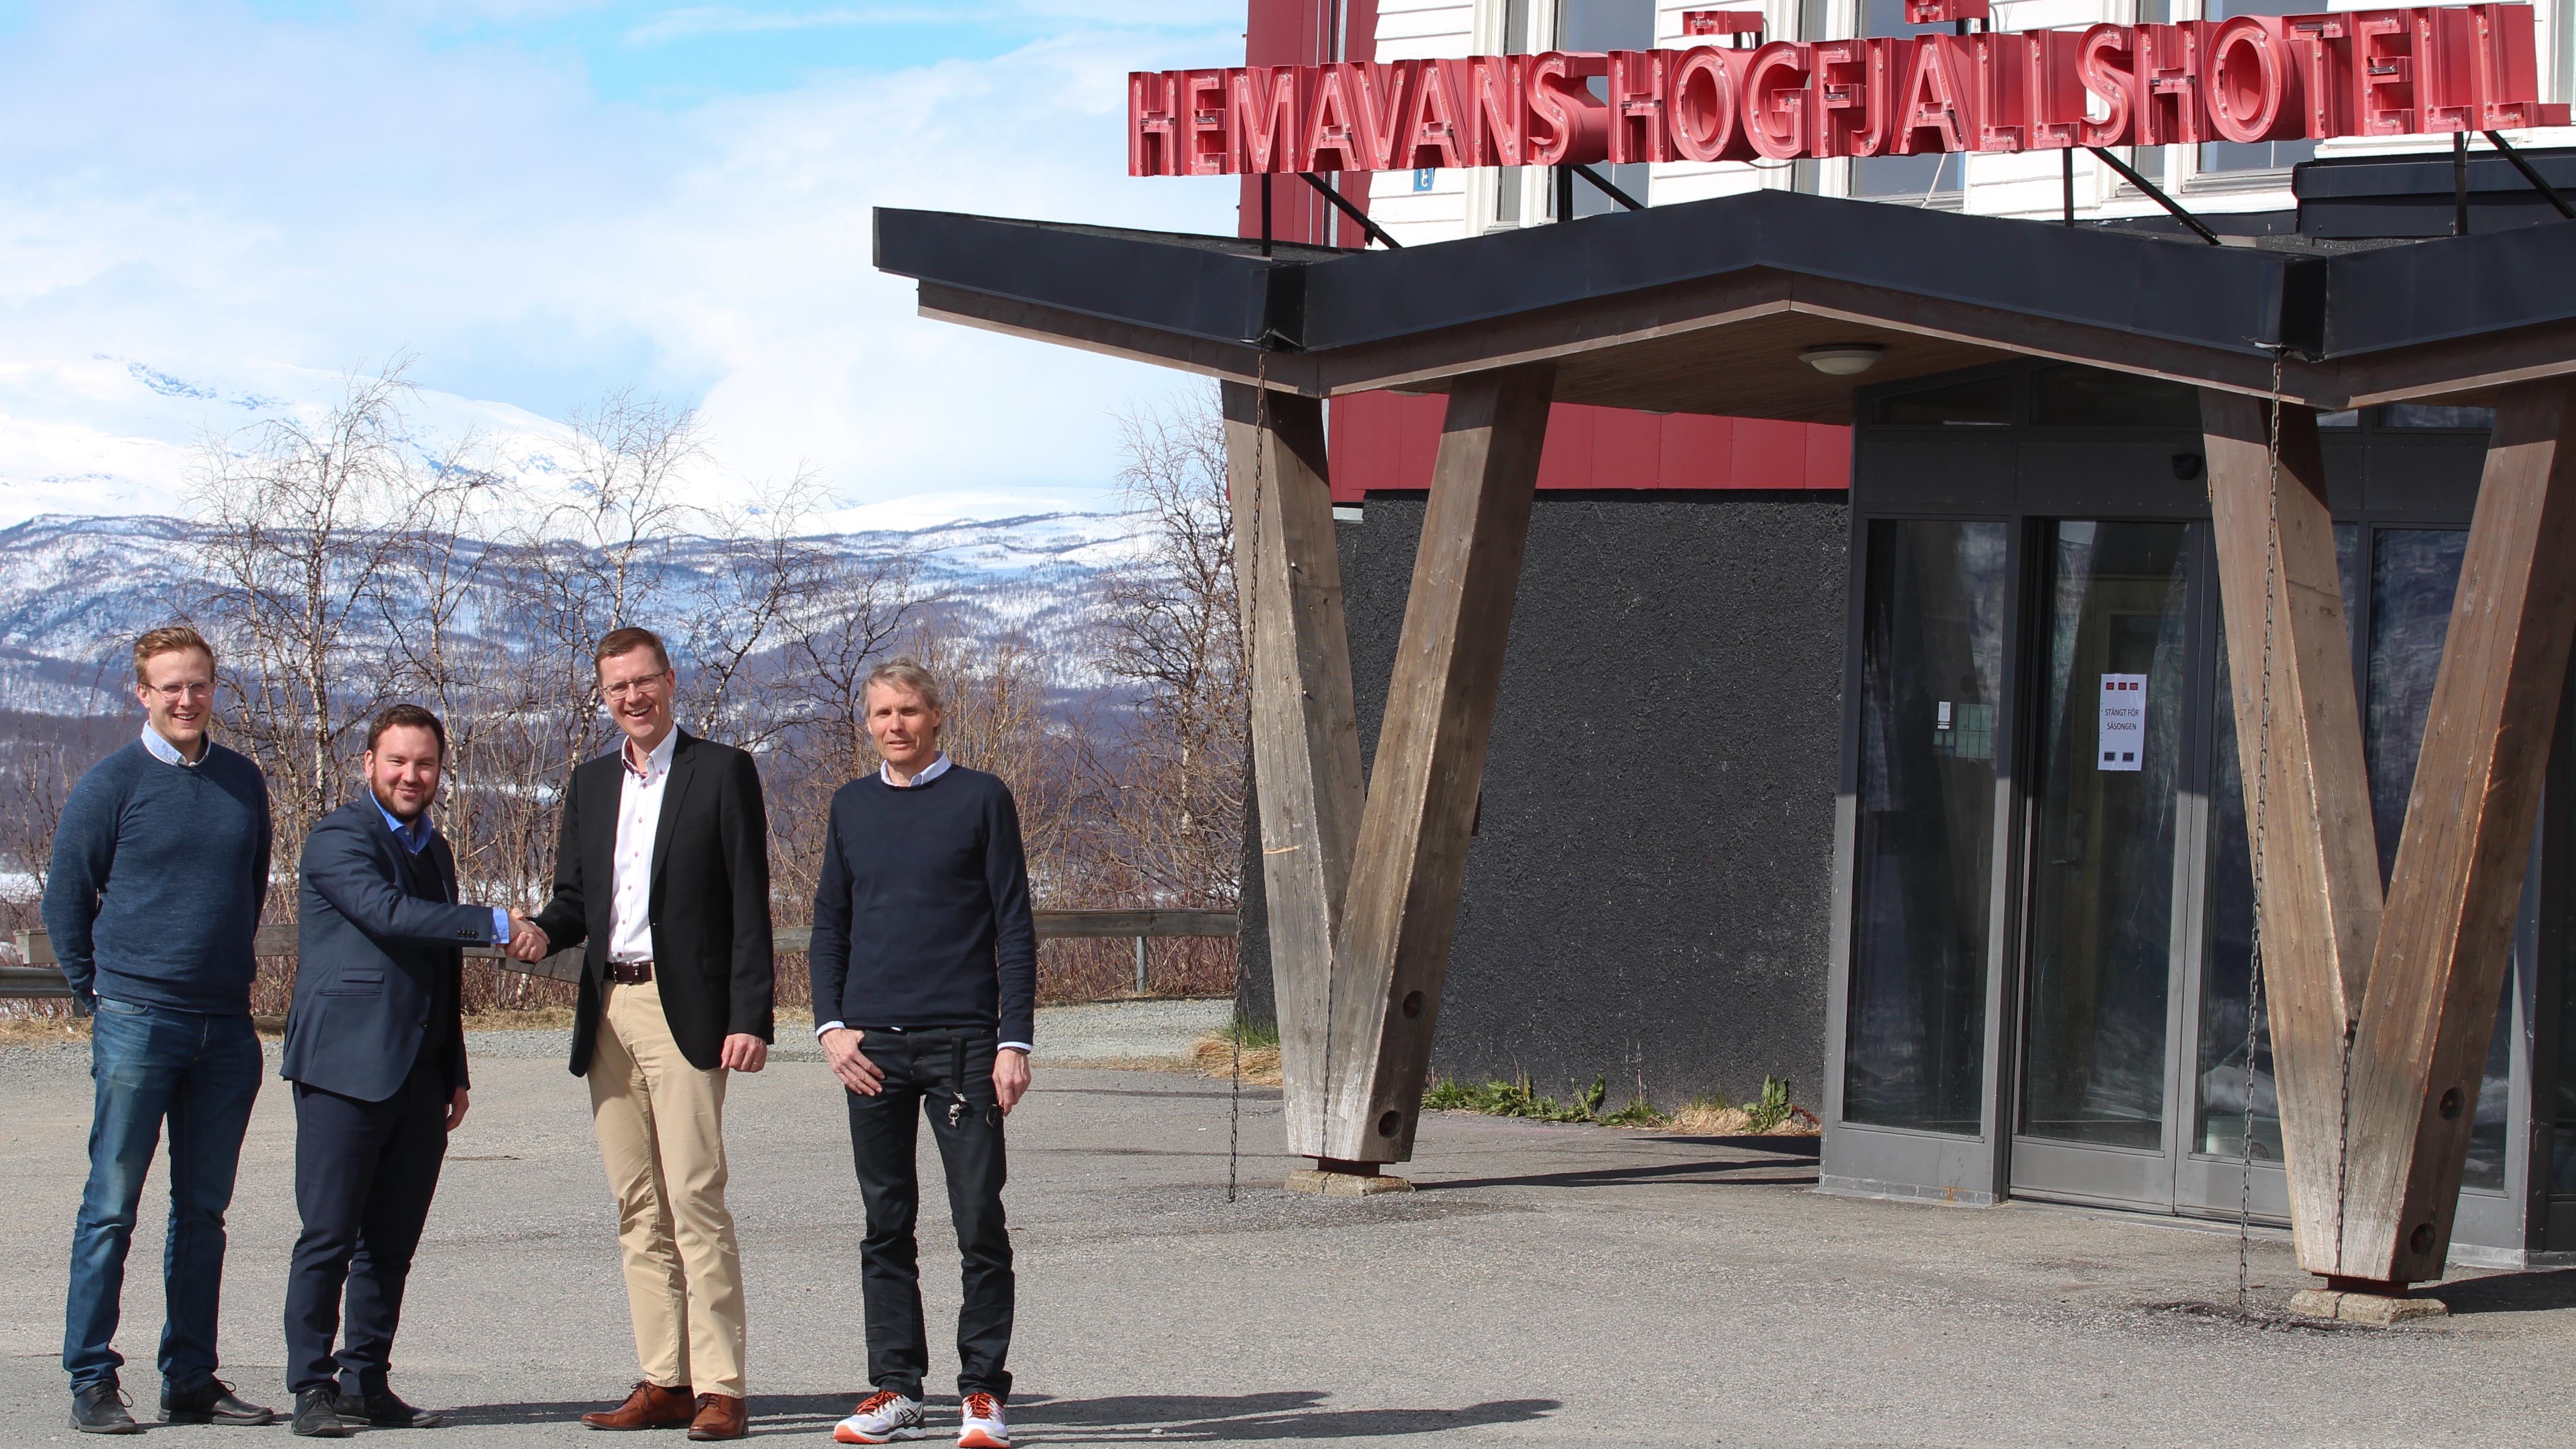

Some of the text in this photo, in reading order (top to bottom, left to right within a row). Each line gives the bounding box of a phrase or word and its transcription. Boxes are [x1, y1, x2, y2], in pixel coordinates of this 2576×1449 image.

[1128, 0, 2537, 176] HEMAVANS HÖGFJÄLLSHOTELL
[2105, 707, 2138, 716] STÄNGT FÖR
[2107, 721, 2136, 730] SÄSONGEN
